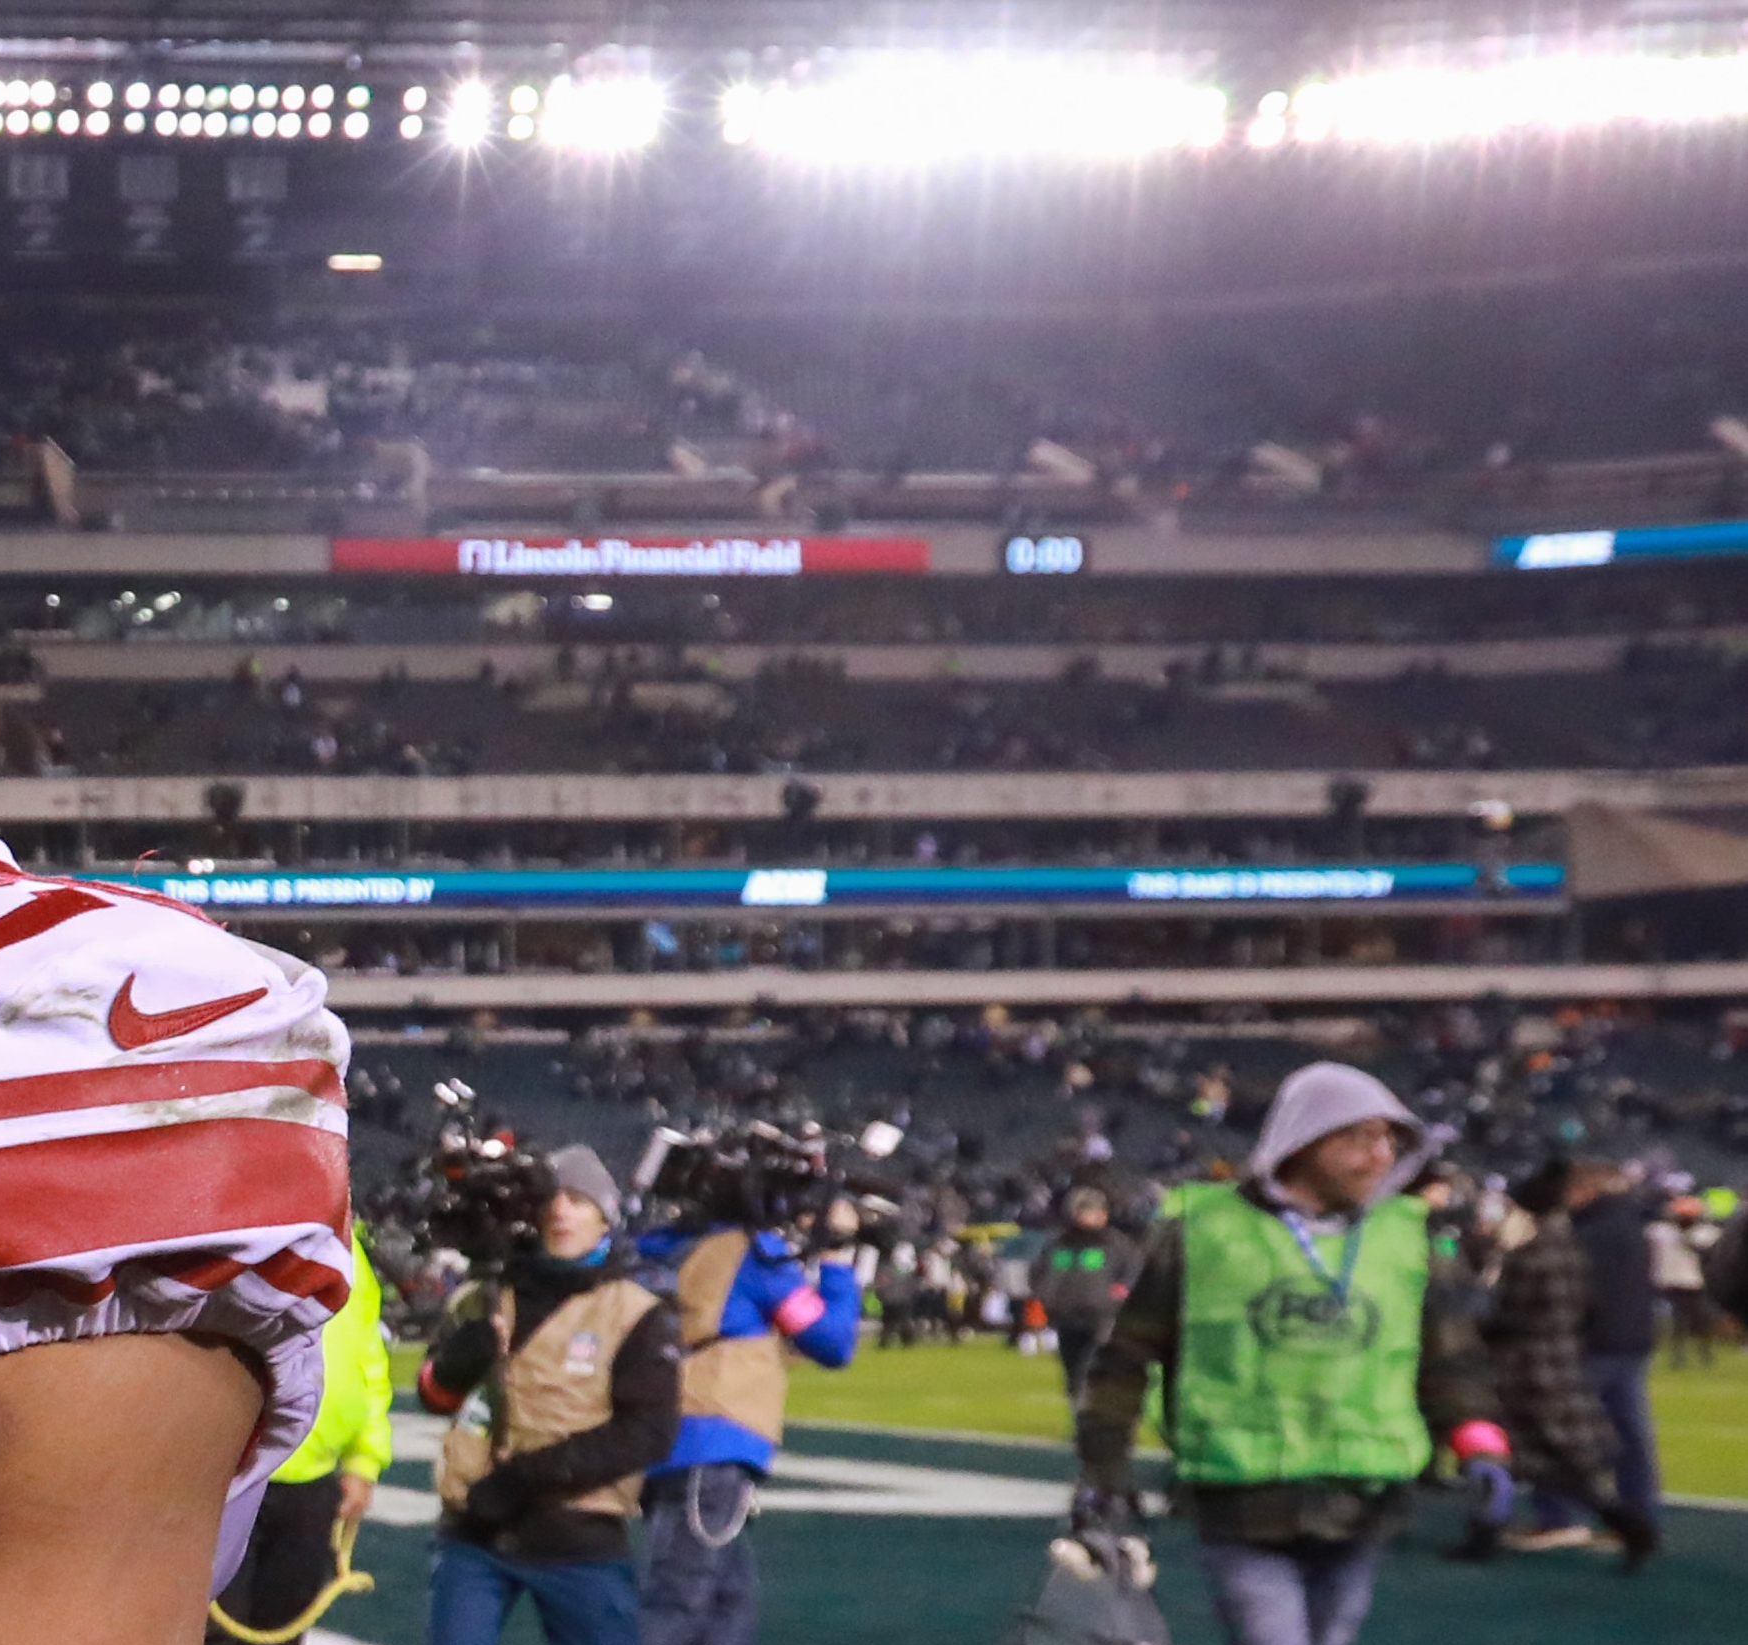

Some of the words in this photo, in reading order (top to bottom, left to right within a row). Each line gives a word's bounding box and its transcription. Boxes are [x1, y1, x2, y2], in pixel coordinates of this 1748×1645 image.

[1006, 537, 1083, 573] 0:00
[164, 879, 209, 902] THIS
[406, 877, 435, 902] BY
